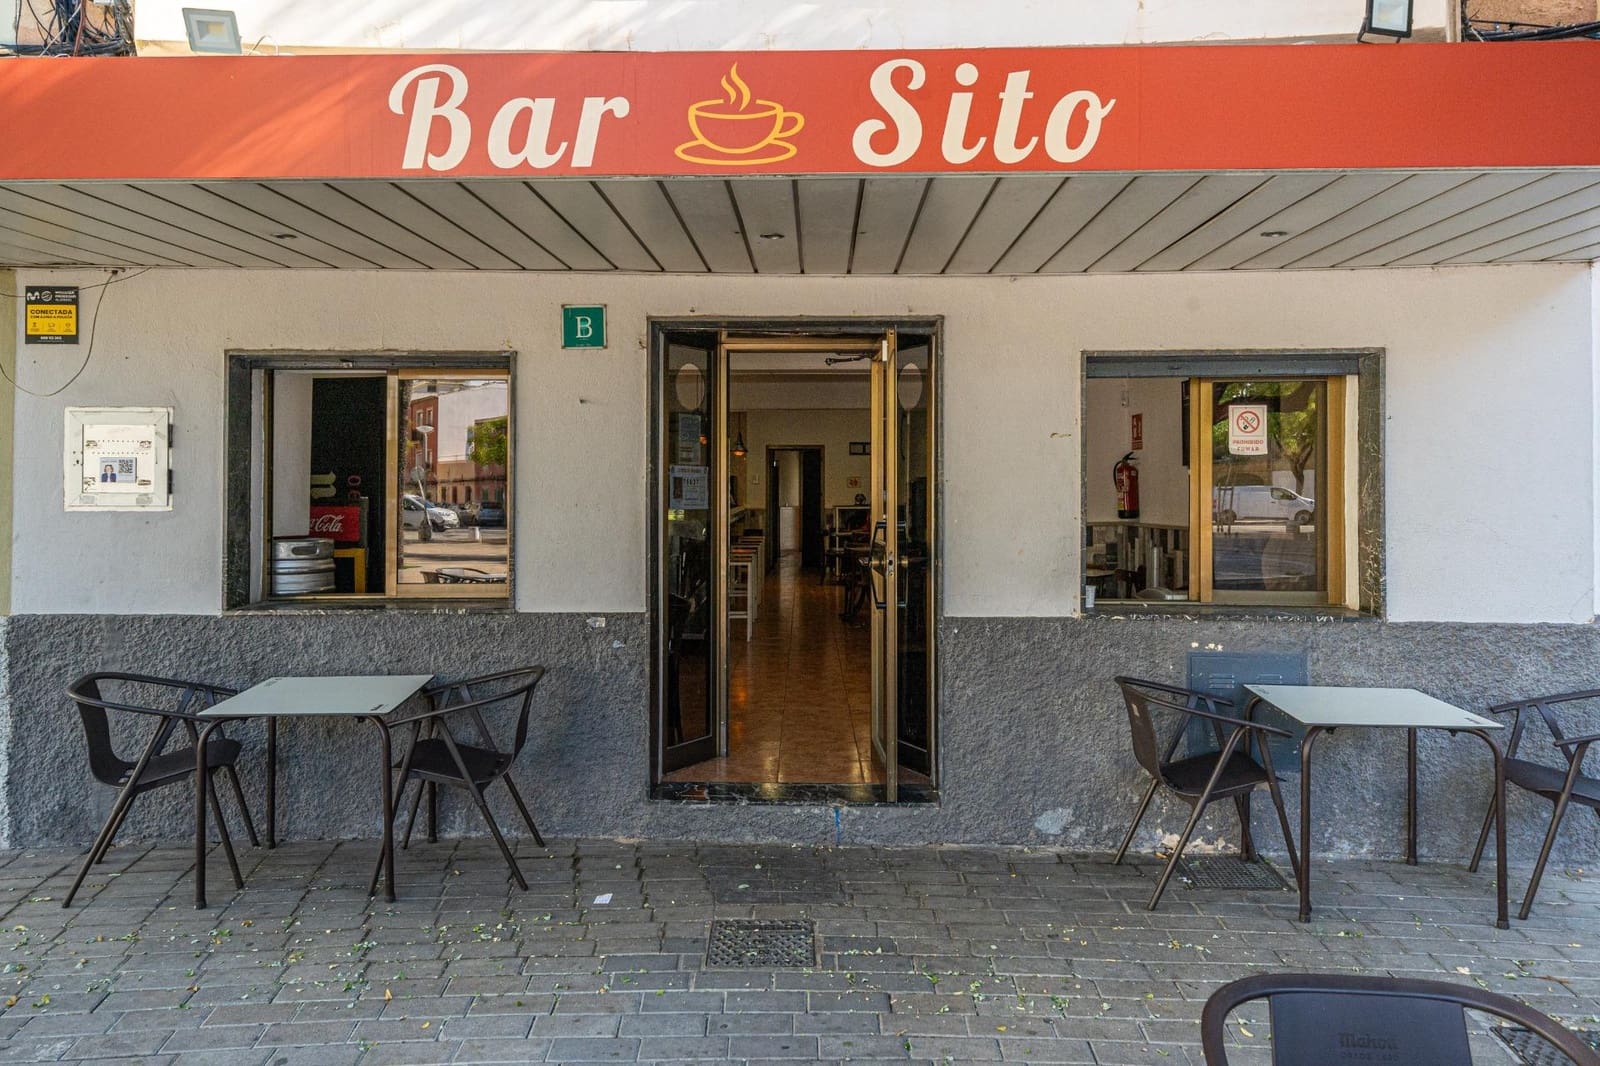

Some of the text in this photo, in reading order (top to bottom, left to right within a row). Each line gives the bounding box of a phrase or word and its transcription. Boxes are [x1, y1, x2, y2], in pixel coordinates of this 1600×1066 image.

[388, 58, 1117, 172] Bar Sito
[575, 315, 593, 339] B
